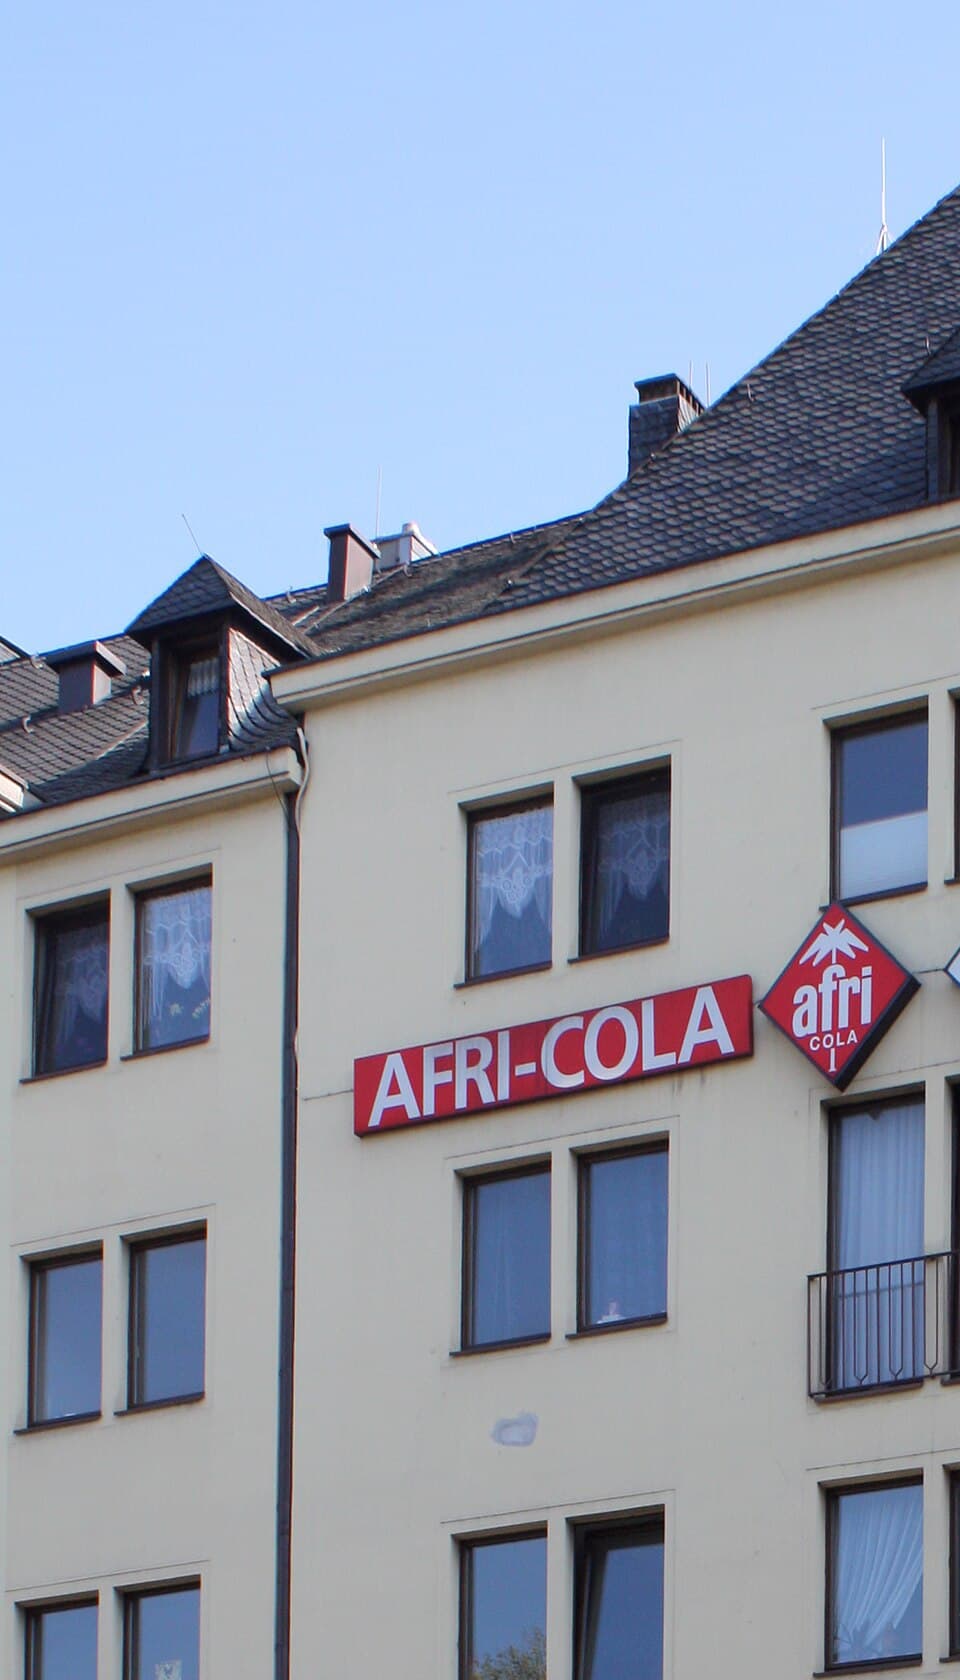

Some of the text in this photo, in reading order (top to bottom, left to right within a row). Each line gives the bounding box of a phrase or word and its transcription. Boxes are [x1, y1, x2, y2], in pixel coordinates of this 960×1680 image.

[792, 964, 872, 1038] afri
[367, 986, 736, 1127] AFRI-COLA
[809, 1029, 858, 1051] COLA
